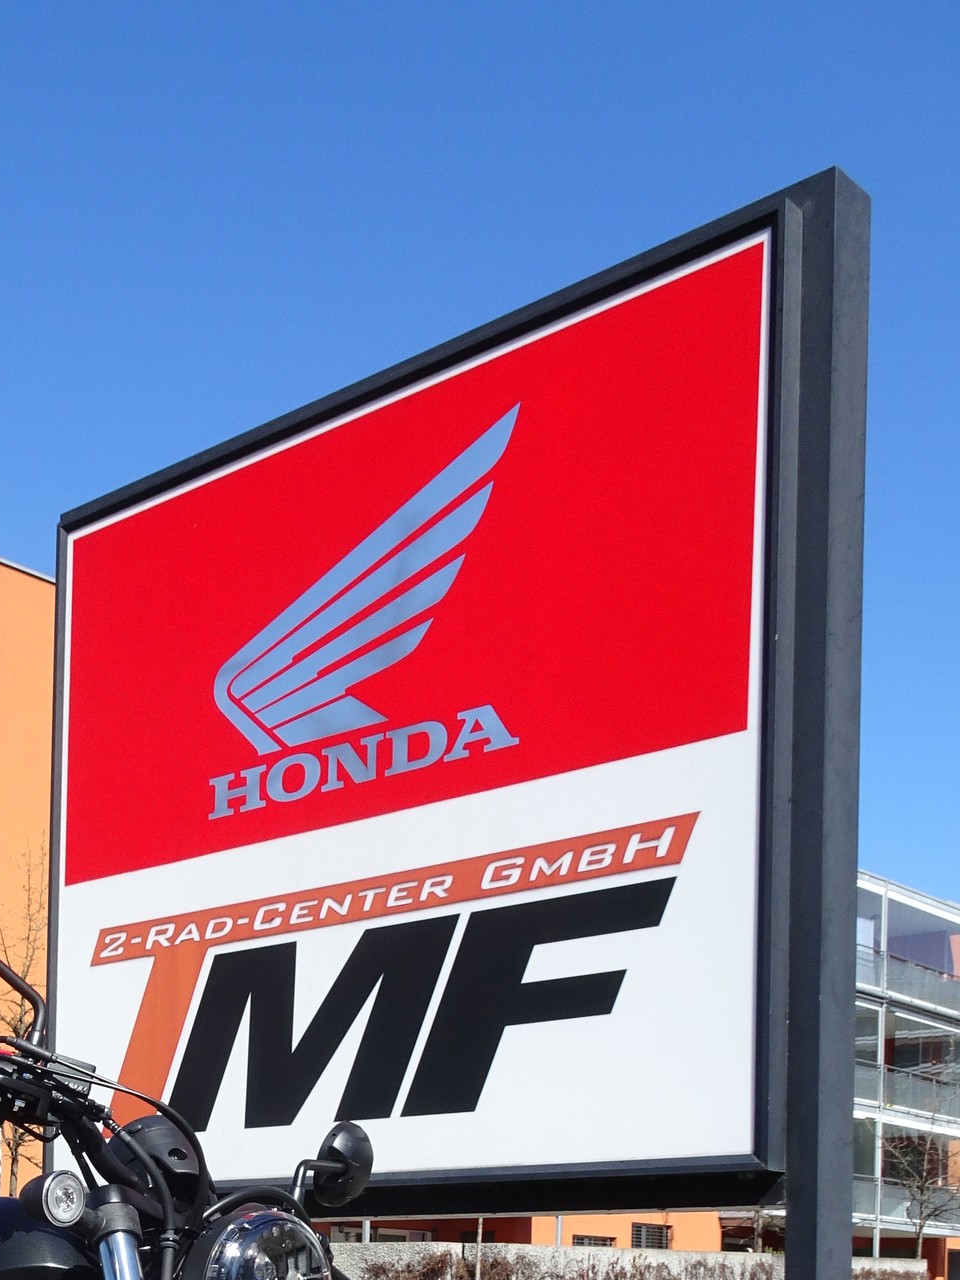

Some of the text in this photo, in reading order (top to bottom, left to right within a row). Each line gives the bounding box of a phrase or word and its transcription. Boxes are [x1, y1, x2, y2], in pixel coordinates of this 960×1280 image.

[208, 704, 520, 820] HONDA
[99, 825, 676, 958] 2-RAD-CENTER GMBH
[90, 876, 677, 1139] TMF
